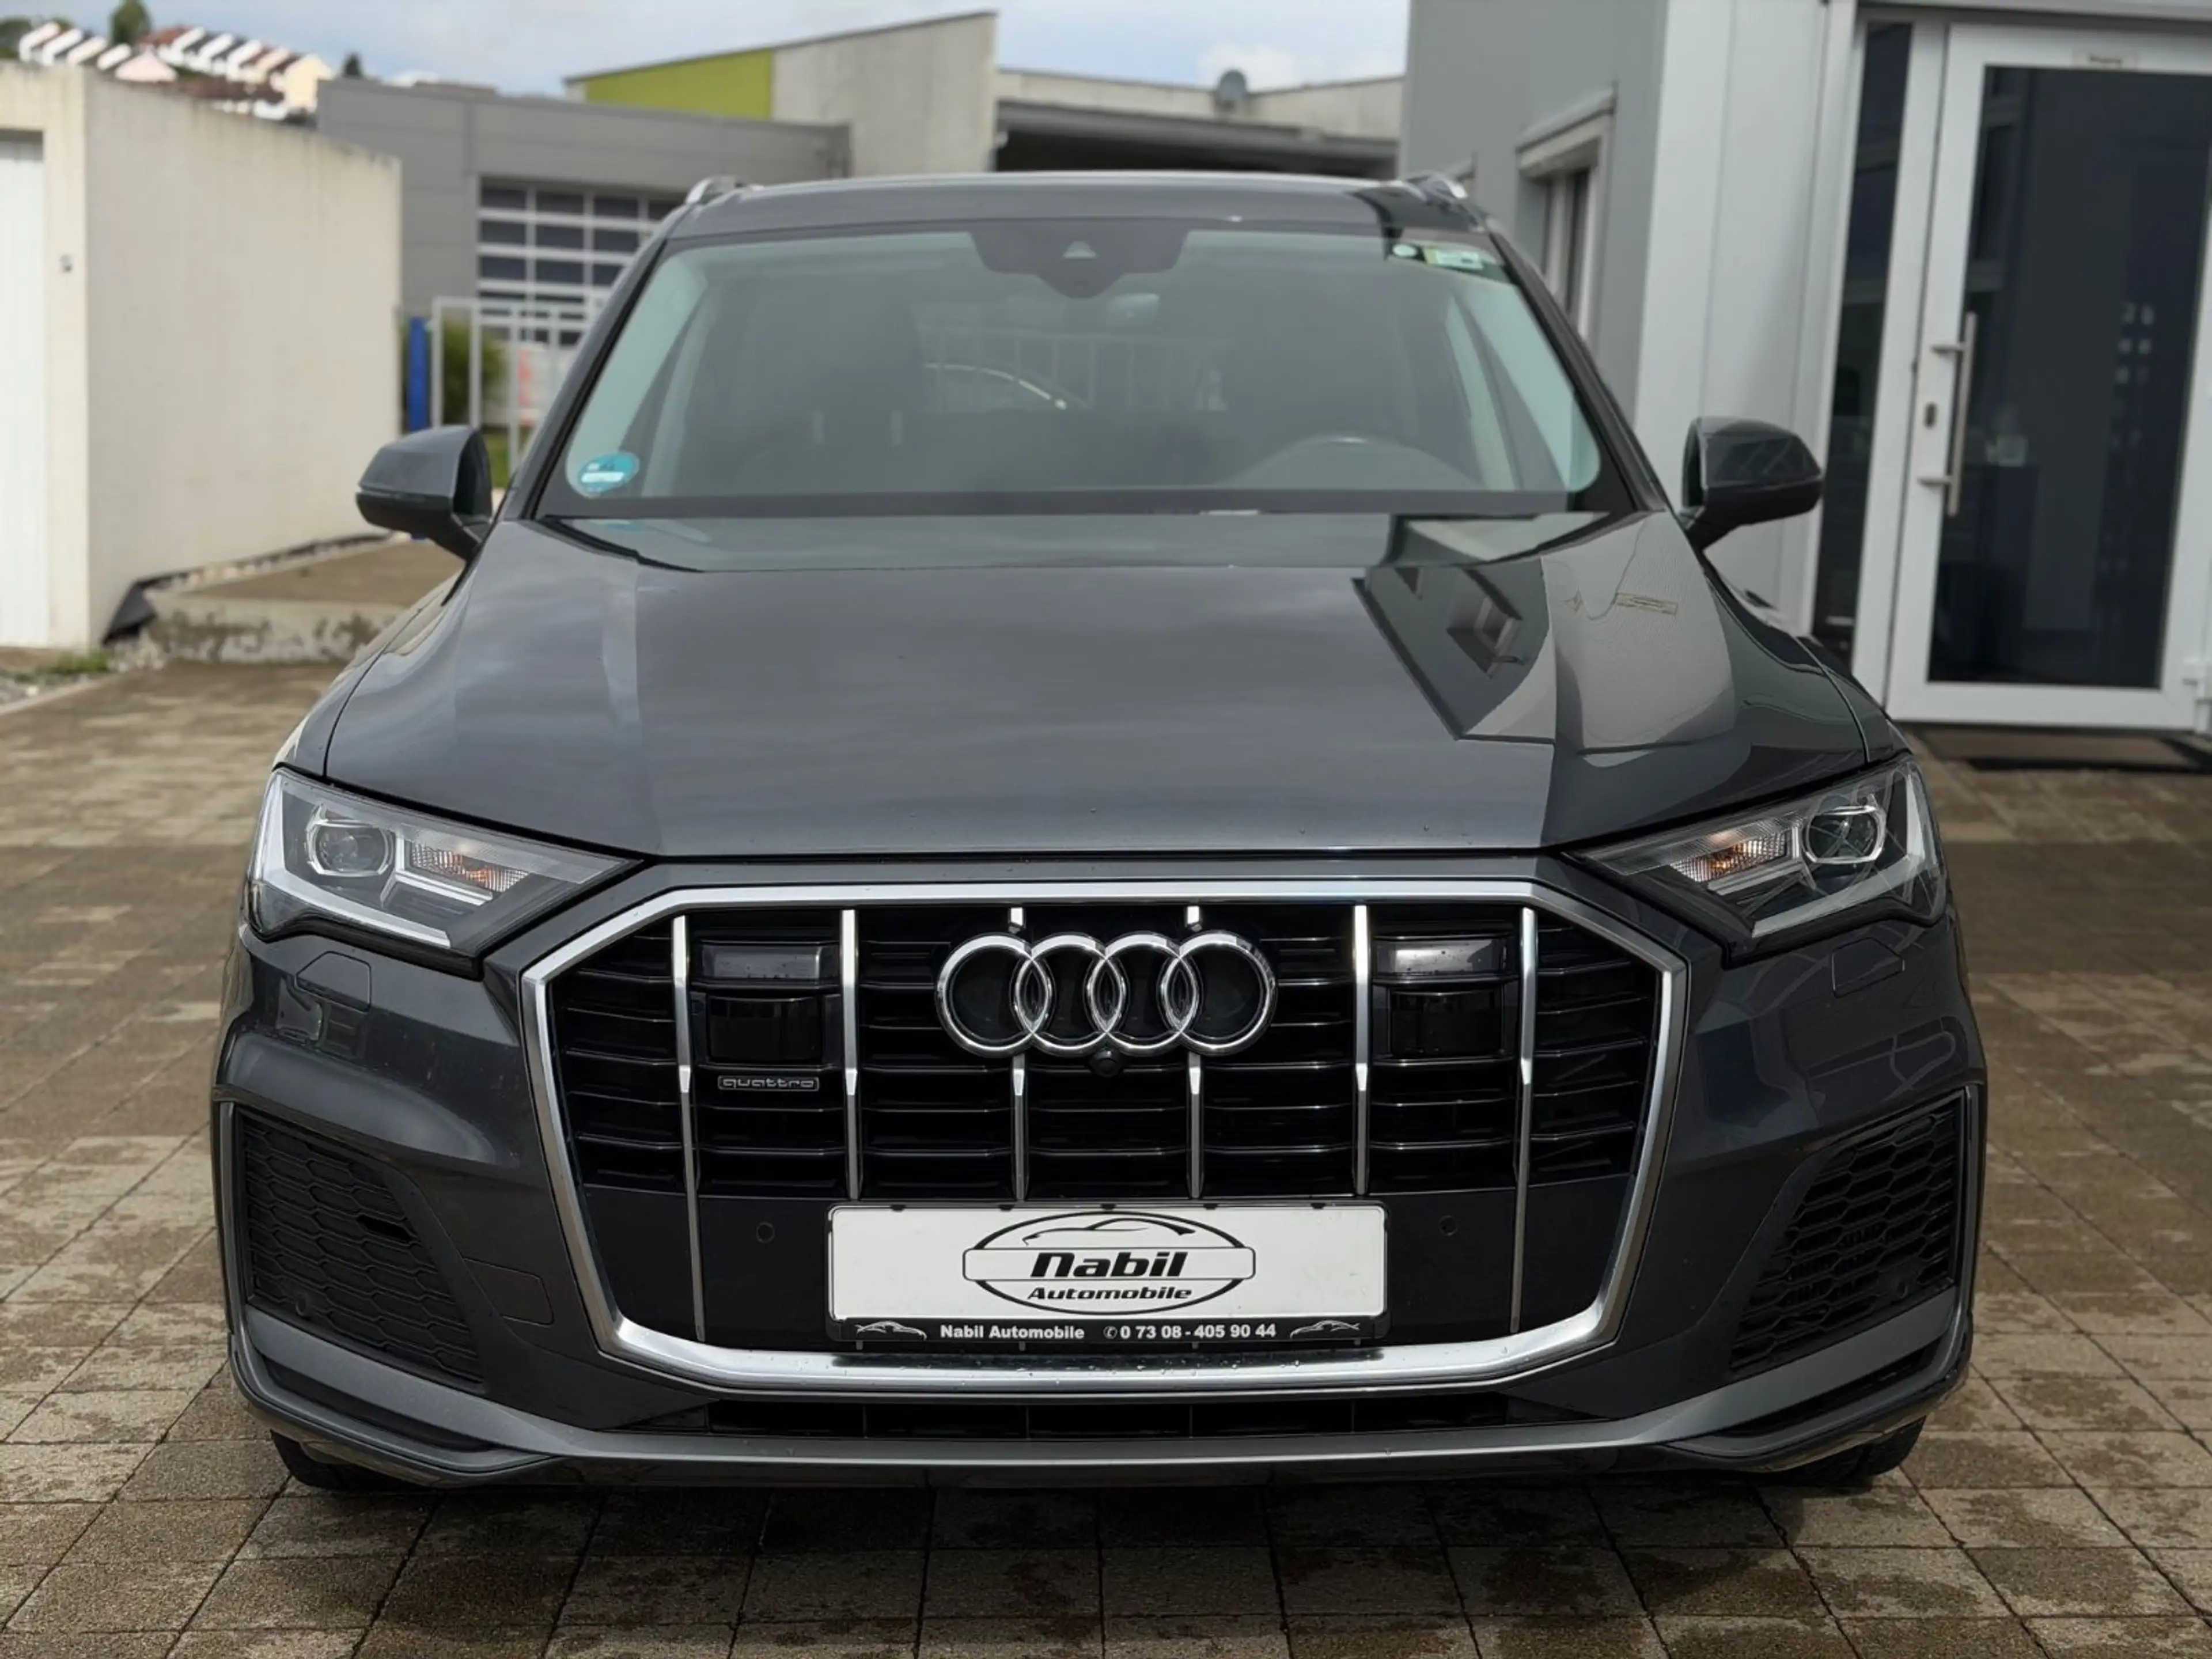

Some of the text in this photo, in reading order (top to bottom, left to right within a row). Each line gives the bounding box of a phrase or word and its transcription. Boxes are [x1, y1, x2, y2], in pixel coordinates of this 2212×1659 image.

[723, 1078, 815, 1088] quattro
[1027, 1286, 1192, 1300] Automobile
[940, 1324, 1085, 1339] Nabil Automobile
[1135, 1325, 1157, 1339] 73
[1229, 1324, 1251, 1338] 90
[1255, 1323, 1277, 1338] 44
